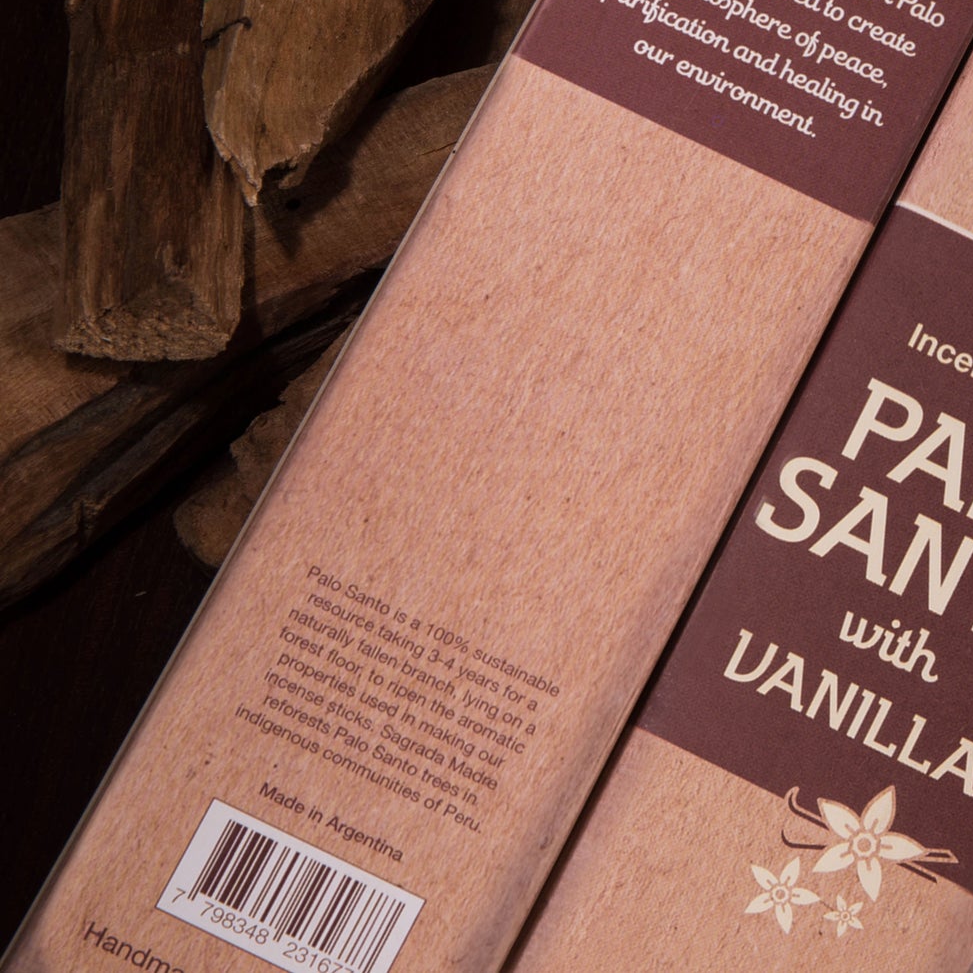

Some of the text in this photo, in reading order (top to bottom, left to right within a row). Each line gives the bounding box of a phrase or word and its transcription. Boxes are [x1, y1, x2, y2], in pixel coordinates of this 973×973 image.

[794, 30, 821, 57] of
[816, 43, 888, 89] peace,
[823, 0, 845, 22] to
[847, 15, 916, 57] create
[633, 39, 816, 138] our environment.
[733, 45, 781, 76] and
[778, 58, 860, 120] healing
[860, 99, 884, 127] in
[288, 609, 536, 736] naturally fallen branch, lying on a
[306, 565, 560, 697] Palo Santo is a 100% sustainable
[307, 593, 538, 712] resource taking 3-4 years for a
[838, 611, 938, 683] with
[264, 668, 498, 791] incense sticks. Sagrada Madre
[277, 653, 506, 768] properties used in making our
[279, 626, 526, 754] forest floor, to ripen the aromatic
[235, 703, 481, 834] indigenous communities of Peru.
[262, 694, 477, 806] reforests Palo Santo trees in
[259, 782, 403, 863] Made in Argentina
[83, 921, 185, 973] Handm
[171, 888, 186, 903] 7
[200, 901, 270, 945] 798348
